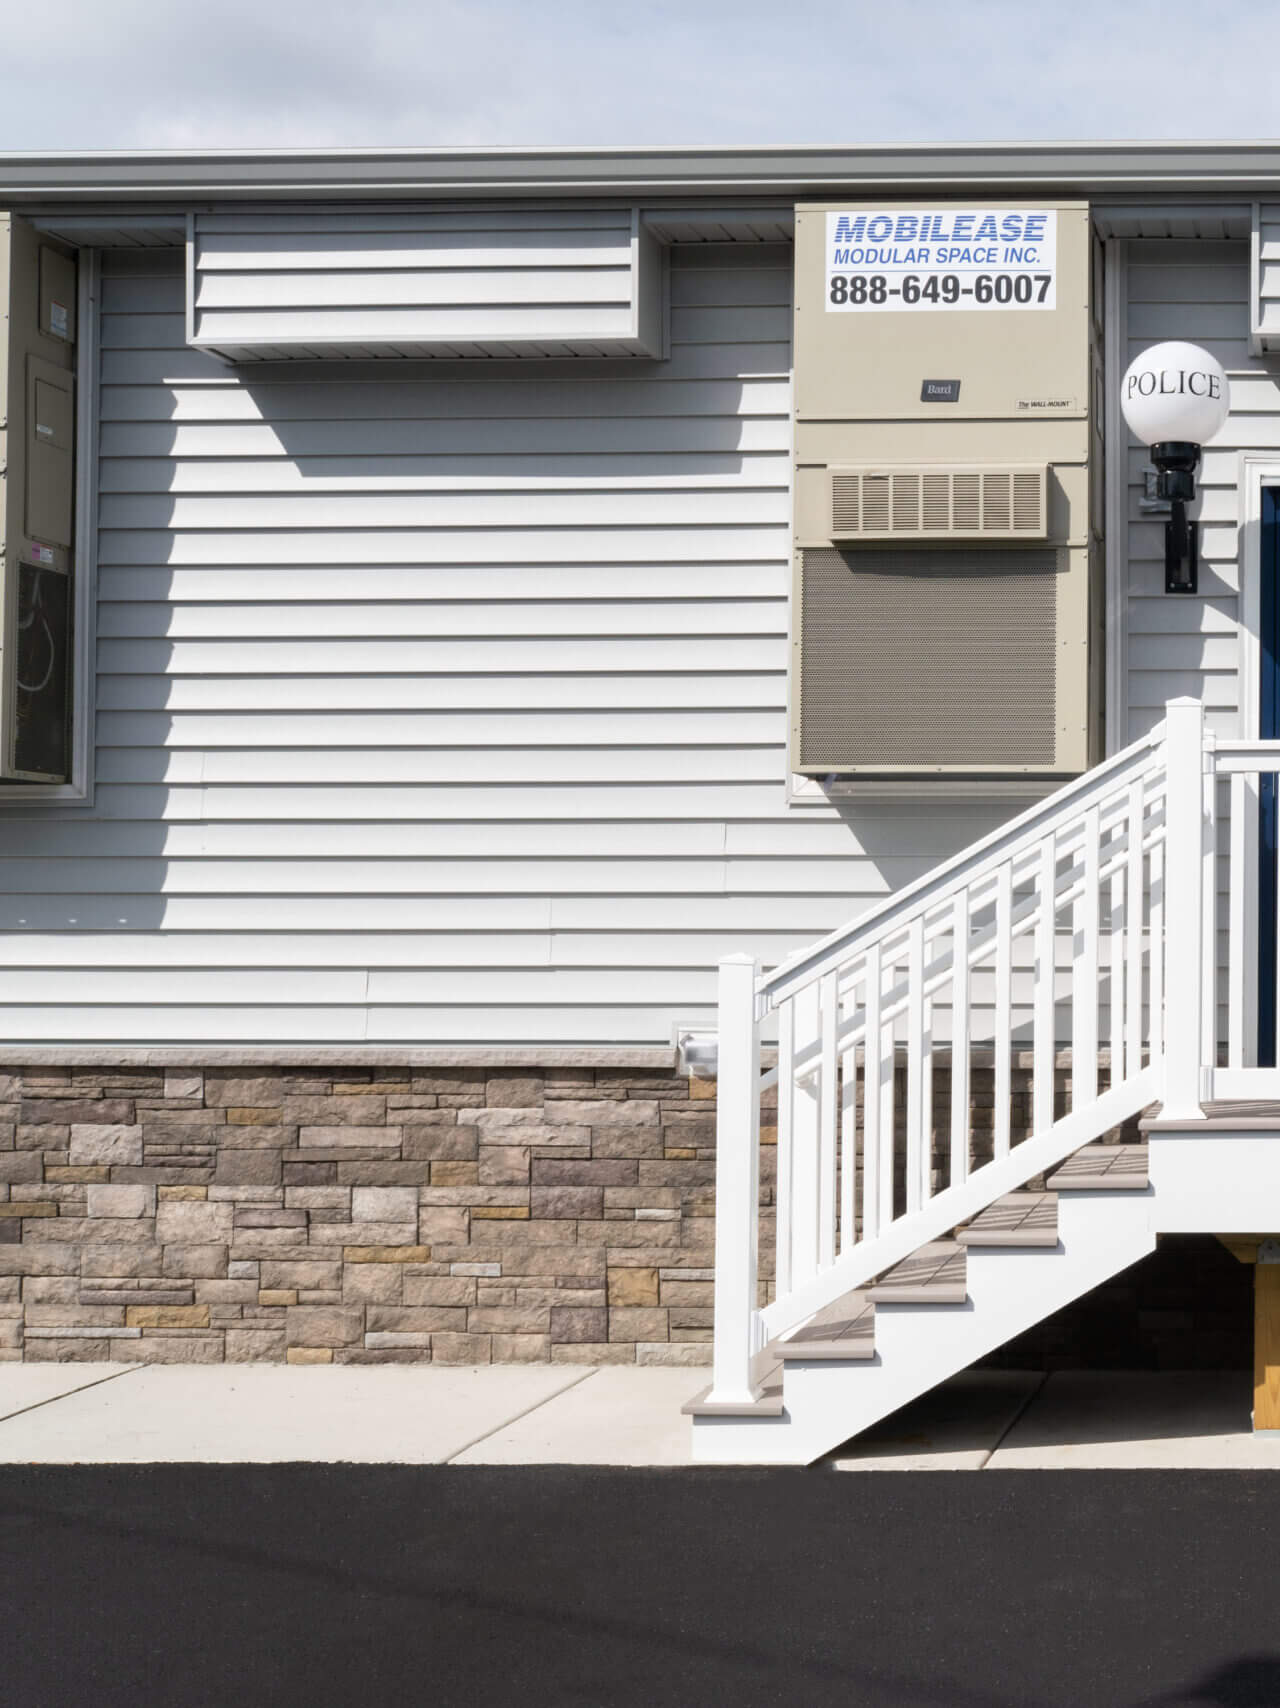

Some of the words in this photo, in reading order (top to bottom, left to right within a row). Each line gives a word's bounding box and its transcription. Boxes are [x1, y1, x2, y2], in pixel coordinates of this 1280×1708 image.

[834, 215, 1048, 243] MOBILEASE
[834, 248, 930, 264] MODULAR
[936, 247, 998, 263] SPACE
[1003, 247, 1041, 263] INC.
[830, 274, 1052, 305] 888-649-6007
[927, 384, 952, 394] Bard
[1128, 370, 1221, 400] POLICE
